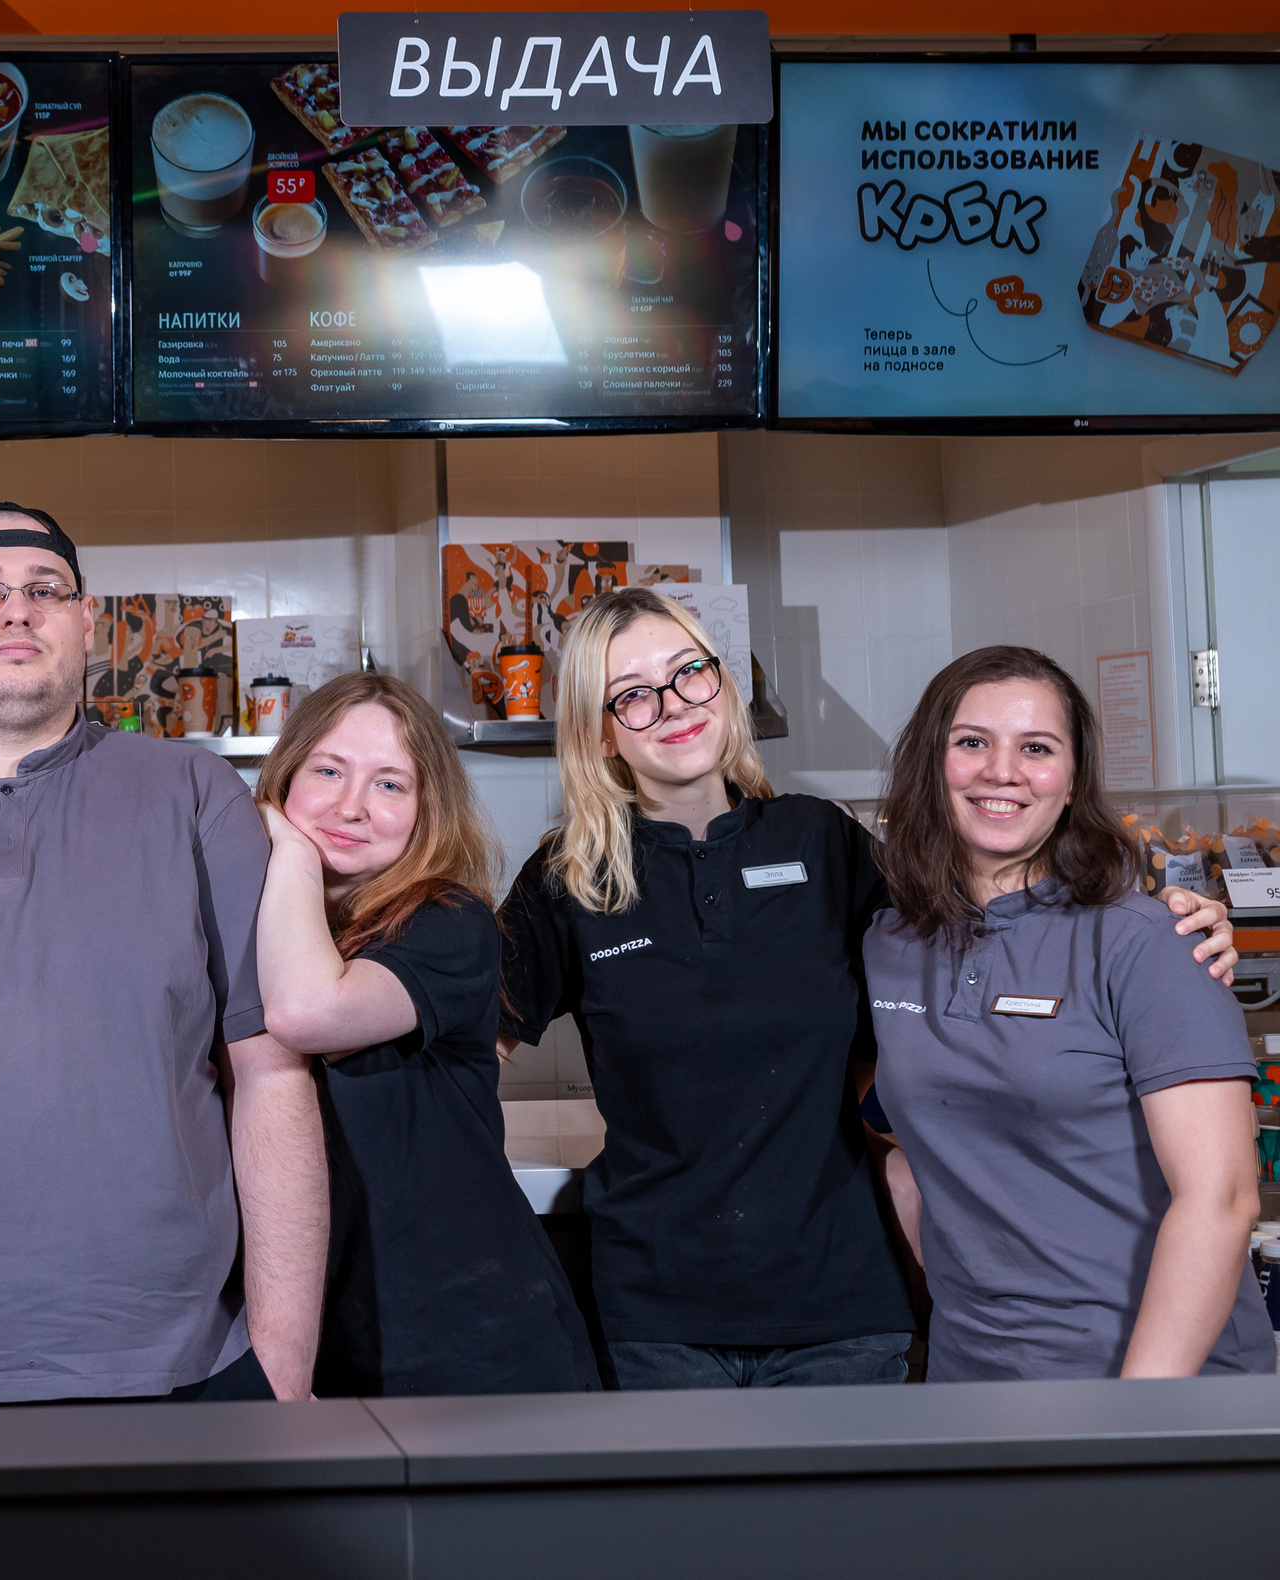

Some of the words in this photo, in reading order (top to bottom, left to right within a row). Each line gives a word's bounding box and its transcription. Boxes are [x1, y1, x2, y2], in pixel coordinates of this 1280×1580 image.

[390, 35, 722, 111] ВЫДАЧА
[35, 101, 68, 110] ТОМАТНЫЙ
[861, 121, 907, 142] МЫ
[914, 121, 1078, 142] СОКРАТИЛИ
[861, 149, 1100, 171] ИСПОЛЬЗОВАНИЕ
[993, 282, 1016, 294] Вот
[1004, 298, 1035, 310] этих
[158, 312, 241, 329] НАПИТКИ
[310, 311, 356, 327] КОФЕ
[602, 336, 639, 345] Фондан
[718, 335, 732, 343] 139
[863, 328, 912, 343] Теперь
[61, 339, 71, 347] 99
[158, 340, 204, 349] Газировка
[310, 339, 361, 348] Американо
[602, 350, 655, 360] Бруслетики
[863, 344, 908, 358] пицца
[912, 345, 919, 356] в
[923, 345, 956, 356] зале
[158, 355, 180, 364] Вода
[310, 353, 354, 363] Капучино
[359, 353, 386, 361] Латте
[429, 352, 443, 360] 149
[158, 368, 206, 378] Молочный
[207, 368, 249, 378] коктейль
[284, 368, 297, 376] 175
[310, 367, 356, 378] Ореховый
[392, 367, 406, 375] 119
[429, 367, 443, 375] 169
[456, 366, 514, 377] Шоколадный
[578, 365, 588, 373] 95
[602, 364, 645, 374] Рулетики
[652, 363, 691, 374] корицей
[718, 364, 732, 372] 105
[863, 361, 880, 372] на
[884, 360, 945, 374] подносе
[62, 386, 76, 394] 169
[310, 383, 334, 392] Флэт
[335, 383, 356, 393] уайт
[392, 383, 402, 391] 99
[455, 382, 496, 392] Сырники
[602, 380, 643, 389] Слоеные
[644, 380, 681, 389] палочки
[717, 380, 732, 388] 229
[589, 946, 620, 962] DODO
[620, 937, 652, 954] PIZZA
